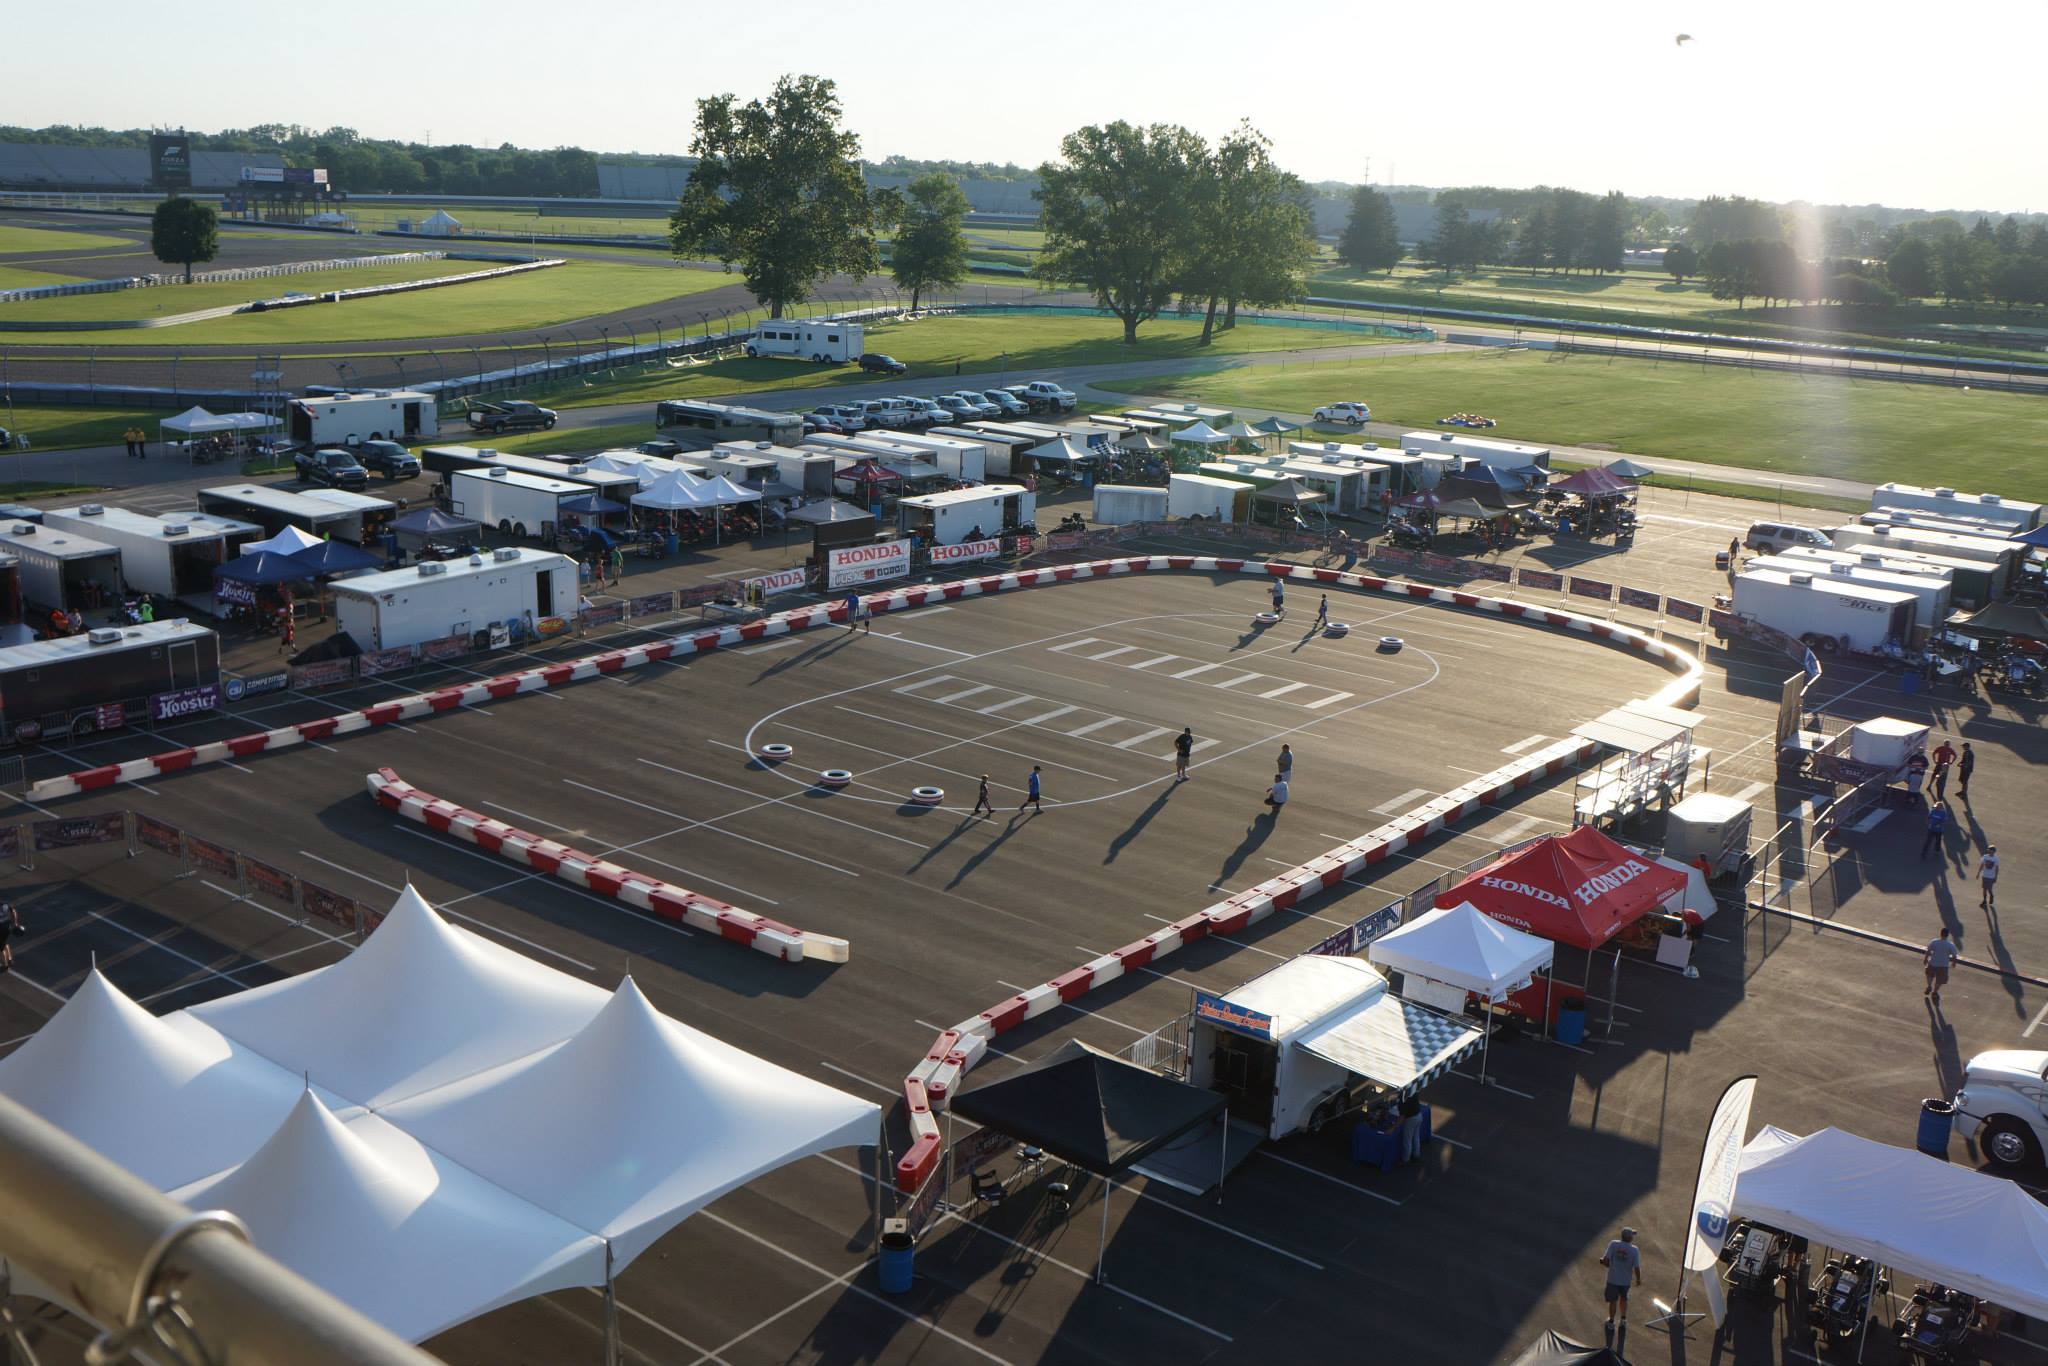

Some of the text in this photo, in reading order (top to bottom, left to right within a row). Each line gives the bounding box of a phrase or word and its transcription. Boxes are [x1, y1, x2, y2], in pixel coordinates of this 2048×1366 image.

[838, 543, 903, 565] HONDA
[933, 541, 999, 560] HONDA
[752, 571, 804, 588] ONDA
[157, 694, 217, 719] Hoosier
[1479, 875, 1572, 911] HONDA
[1573, 859, 1650, 906] HONDA
[1489, 911, 1532, 929] HONDA
